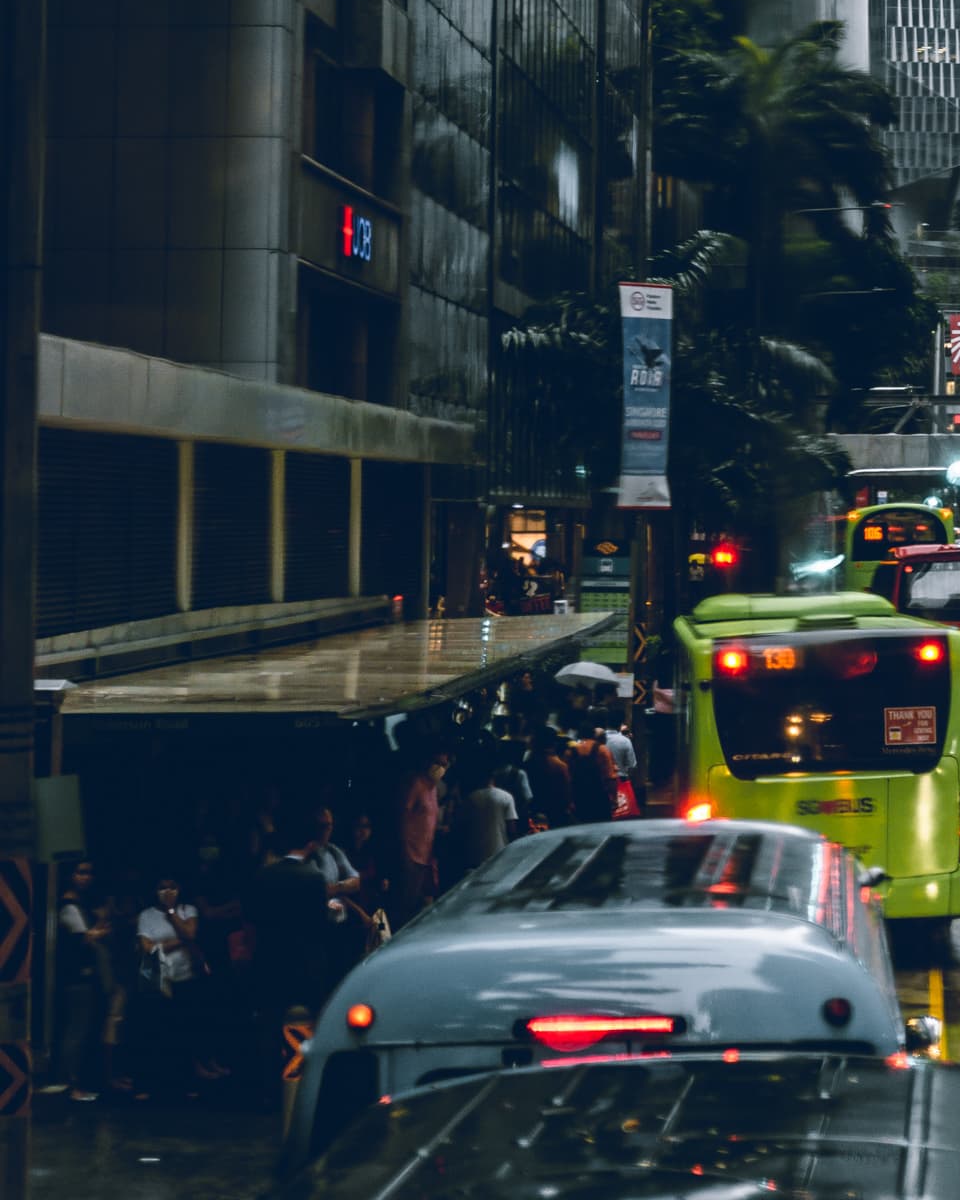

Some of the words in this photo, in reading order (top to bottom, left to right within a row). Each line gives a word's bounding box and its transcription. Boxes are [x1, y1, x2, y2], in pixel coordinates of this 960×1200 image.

[352, 215, 372, 262] UOB
[863, 525, 883, 541] 106
[887, 710, 914, 720] THANK
[916, 709, 933, 719] YOU
